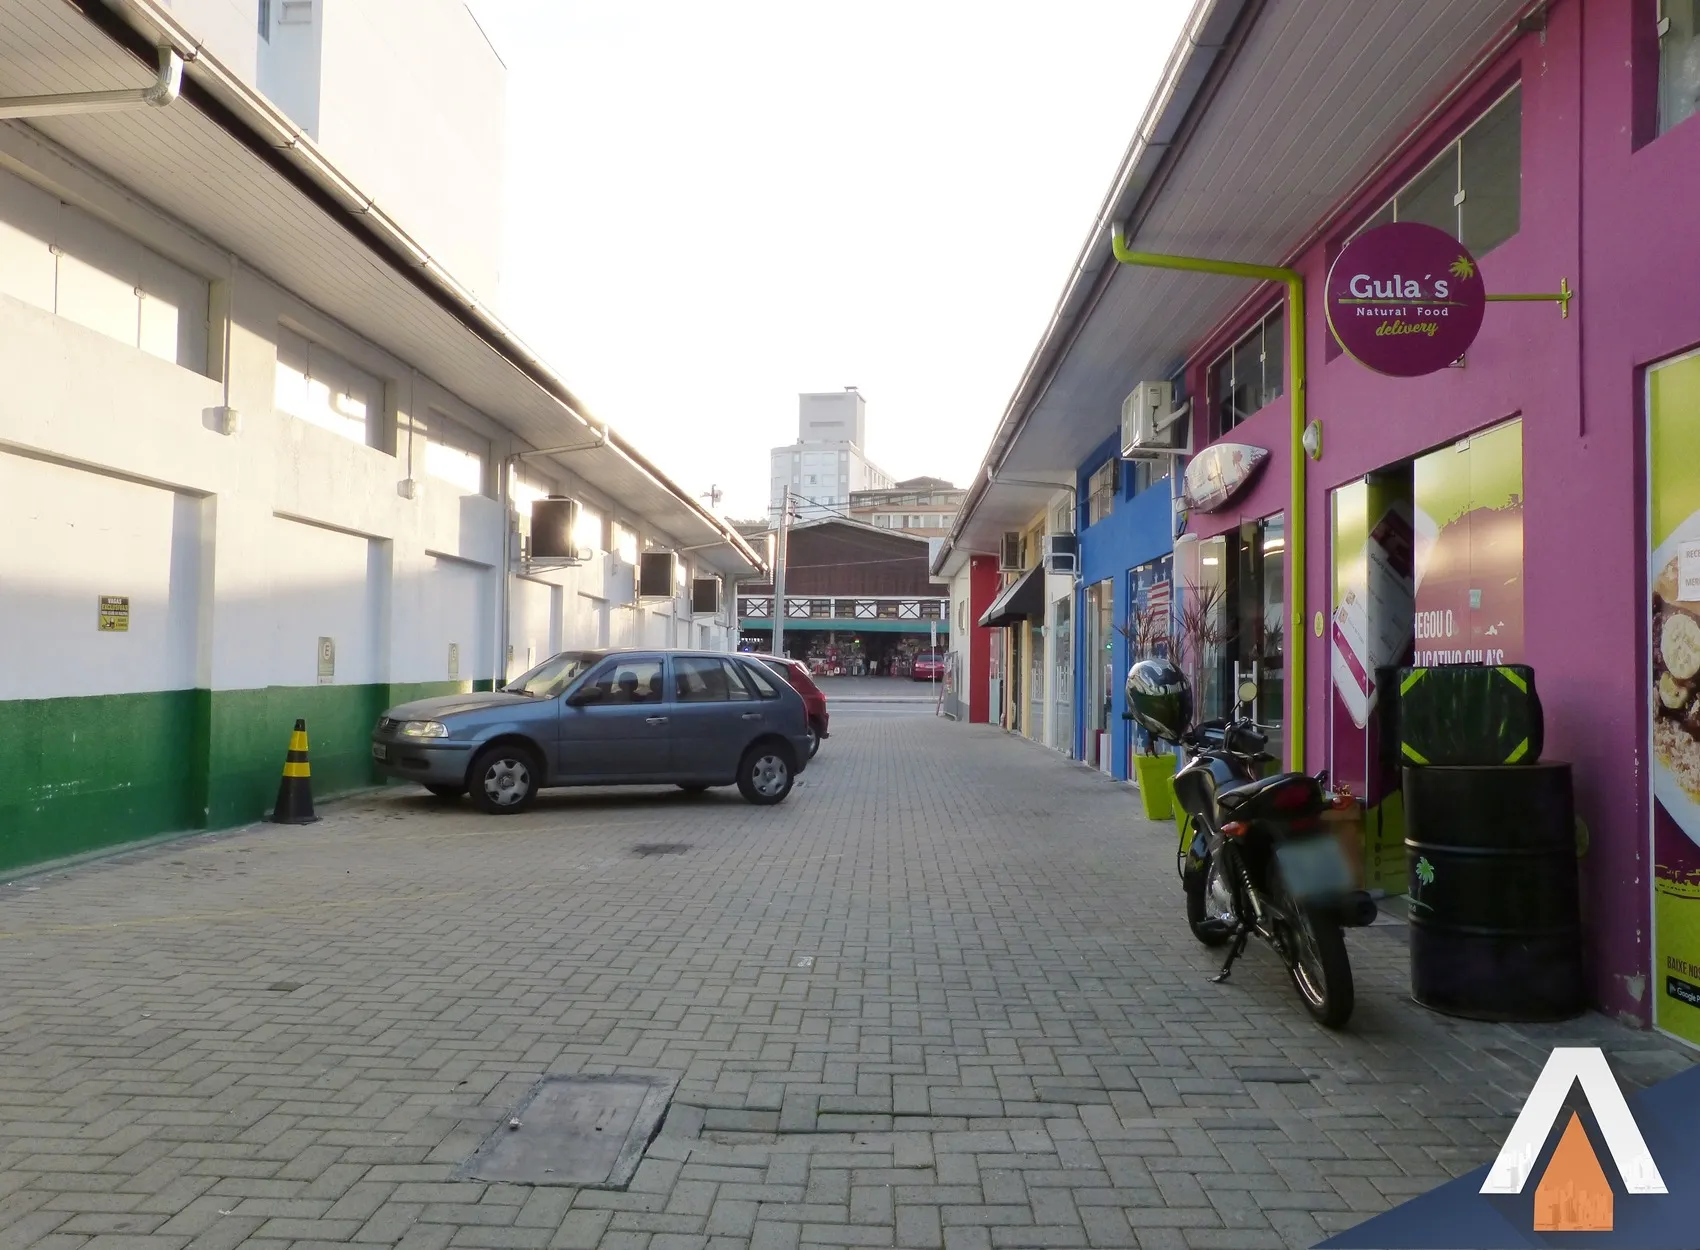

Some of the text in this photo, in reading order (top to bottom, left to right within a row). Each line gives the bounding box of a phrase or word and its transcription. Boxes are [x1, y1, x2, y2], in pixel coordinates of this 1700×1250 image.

[1356, 307, 1449, 316] Natural Food
[1375, 320, 1439, 337] delivery
[1445, 609, 1453, 638] O
[1667, 955, 1688, 974] BAIXE
[1677, 987, 1696, 1002] Google
